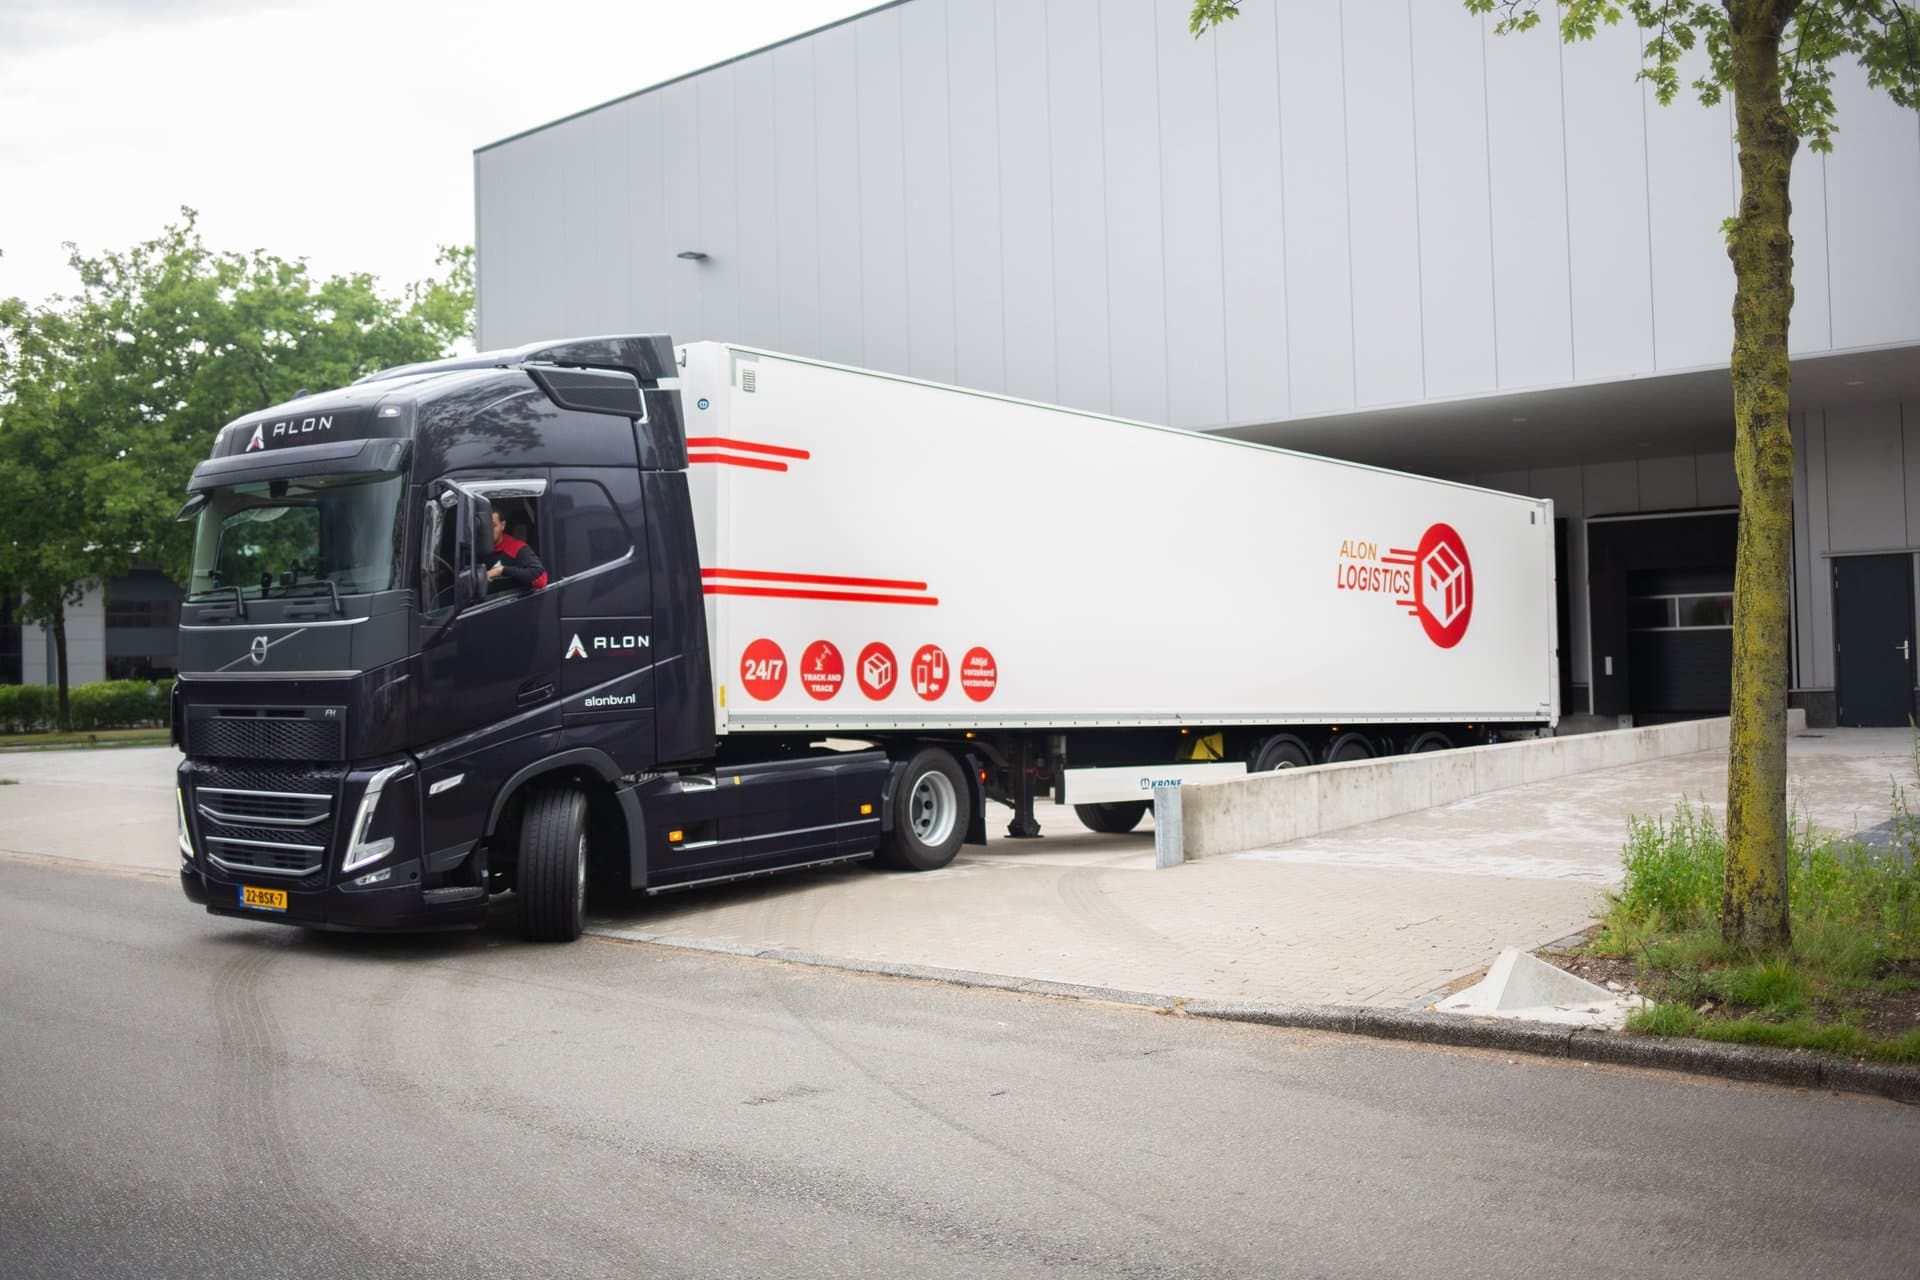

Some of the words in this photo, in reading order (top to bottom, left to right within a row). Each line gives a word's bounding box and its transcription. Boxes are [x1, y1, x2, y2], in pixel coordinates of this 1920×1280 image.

[273, 415, 333, 437] ALON
[1340, 539, 1377, 561] ALON
[1337, 563, 1411, 594] LOGISTICS
[594, 635, 649, 649] ALON
[744, 659, 784, 681] 24/7
[803, 673, 826, 682] TRACK
[827, 673, 842, 682] AND
[811, 684, 834, 693] TRACE
[584, 693, 636, 707] alonbv.nl
[245, 889, 284, 907] 22-BSK-7
